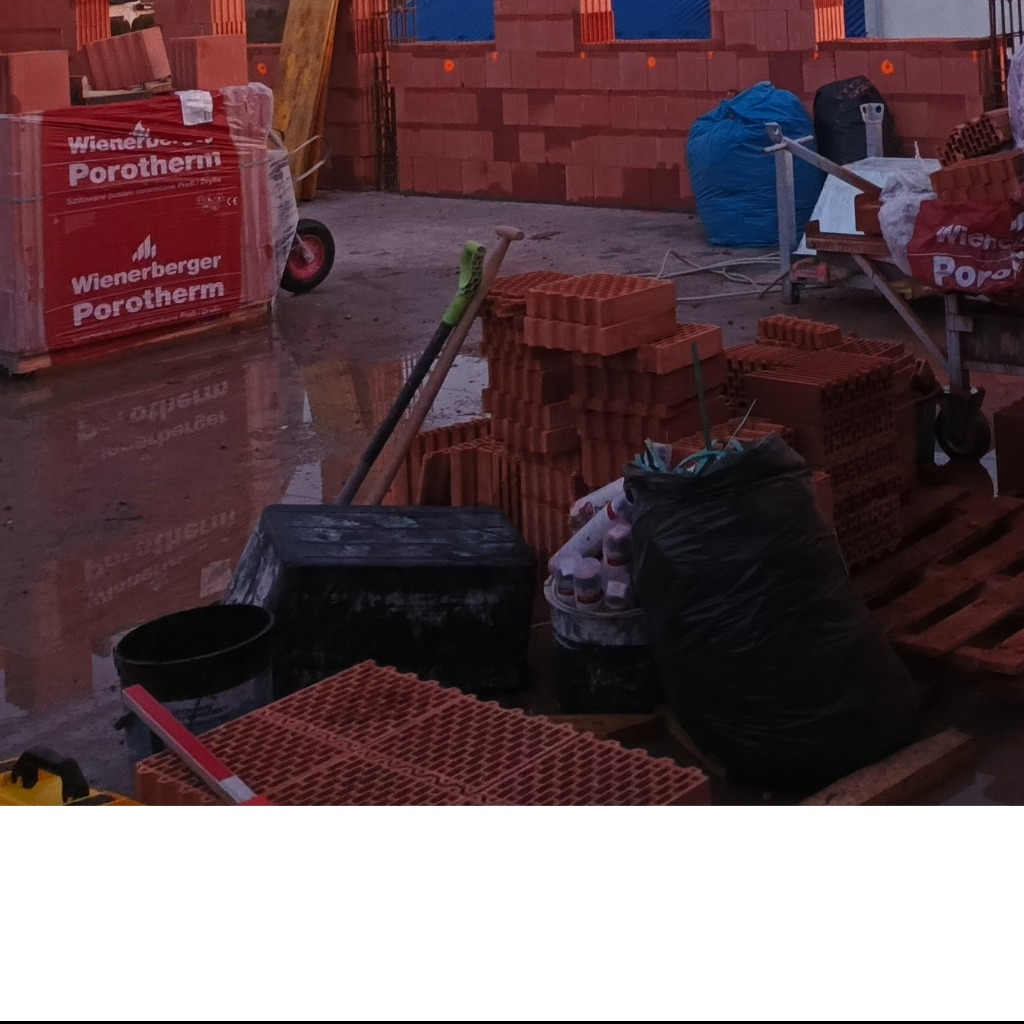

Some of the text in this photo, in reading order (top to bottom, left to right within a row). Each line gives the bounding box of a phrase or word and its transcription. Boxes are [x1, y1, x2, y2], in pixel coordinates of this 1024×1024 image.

[68, 151, 222, 187] Porotherm
[71, 253, 222, 295] Wienerberger
[72, 280, 225, 327] Porotherm
